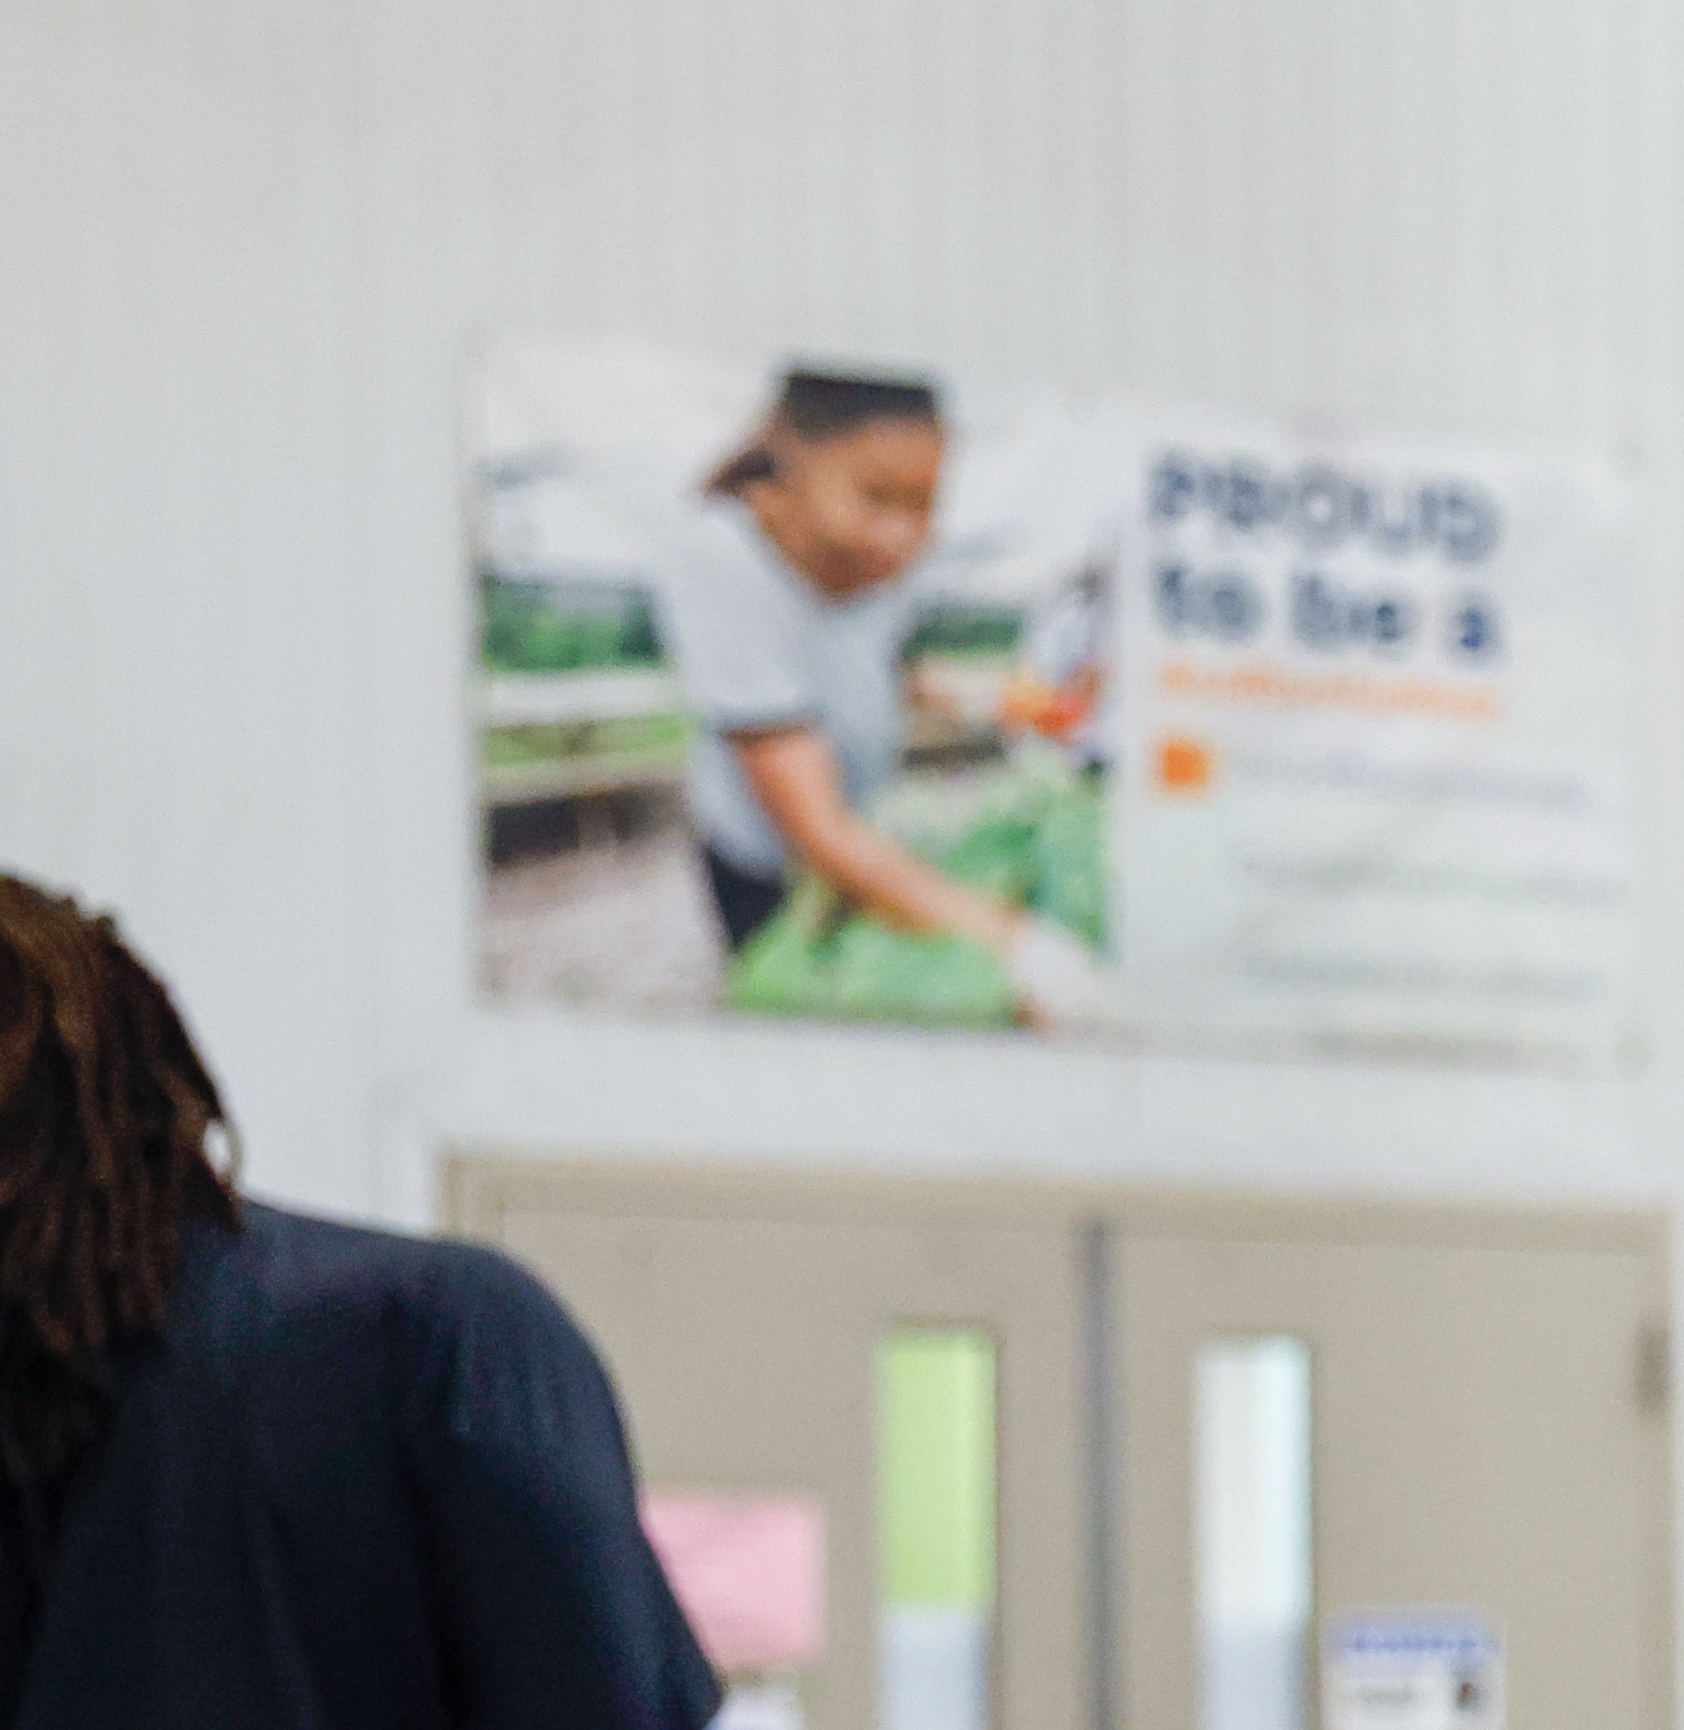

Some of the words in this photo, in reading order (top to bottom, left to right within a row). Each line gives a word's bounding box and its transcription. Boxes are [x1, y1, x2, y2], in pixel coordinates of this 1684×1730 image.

[1150, 450, 1502, 560] PROUD
[1154, 558, 1264, 645] to
[1287, 570, 1418, 658] be
[1441, 592, 1507, 666] a
